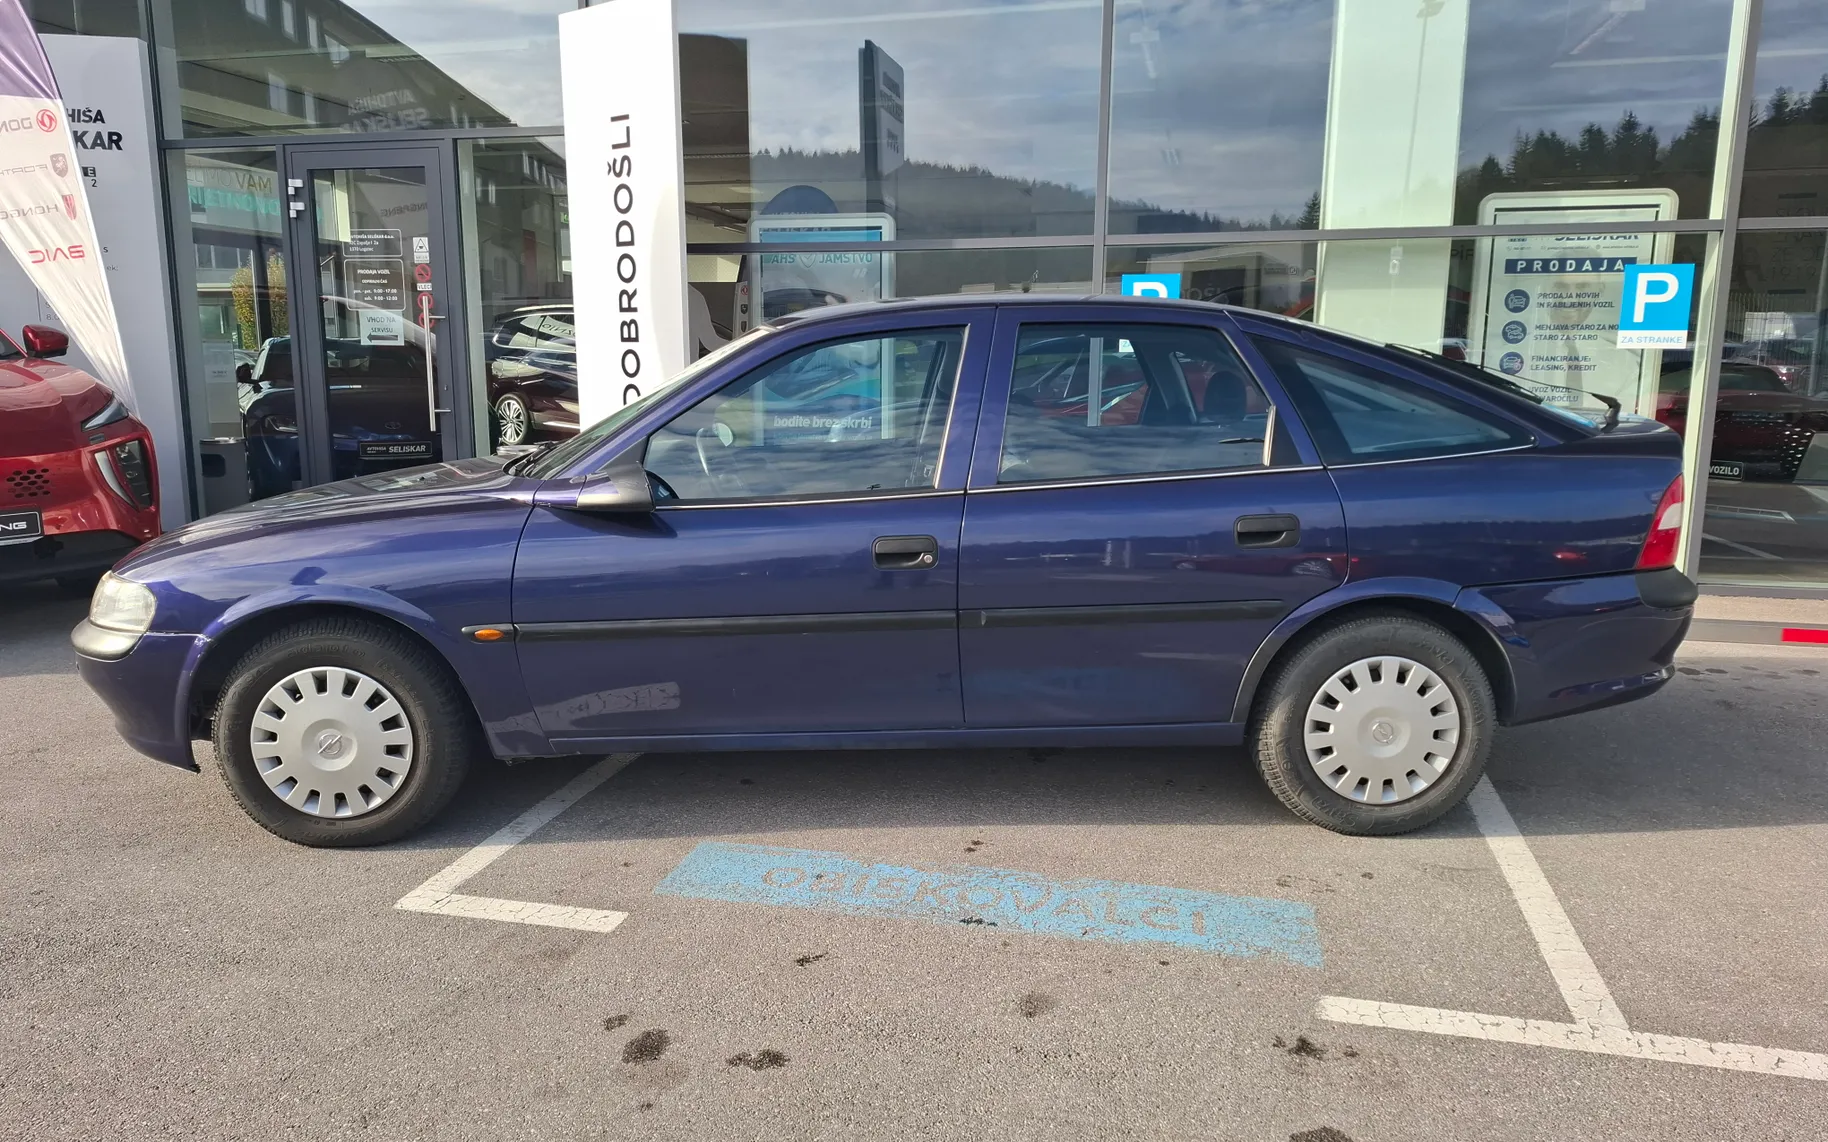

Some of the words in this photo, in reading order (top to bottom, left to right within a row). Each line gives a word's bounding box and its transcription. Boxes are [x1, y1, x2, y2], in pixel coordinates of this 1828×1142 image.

[66, 107, 106, 124] HIŠA
[72, 130, 123, 151] KAR
[235, 171, 273, 195] VAM
[818, 253, 873, 264] JAMSTVO
[1516, 259, 1626, 272] PRODAJA
[1633, 272, 1679, 323] P
[1621, 336, 1634, 344] ZA
[1636, 336, 1683, 344] STRANKE
